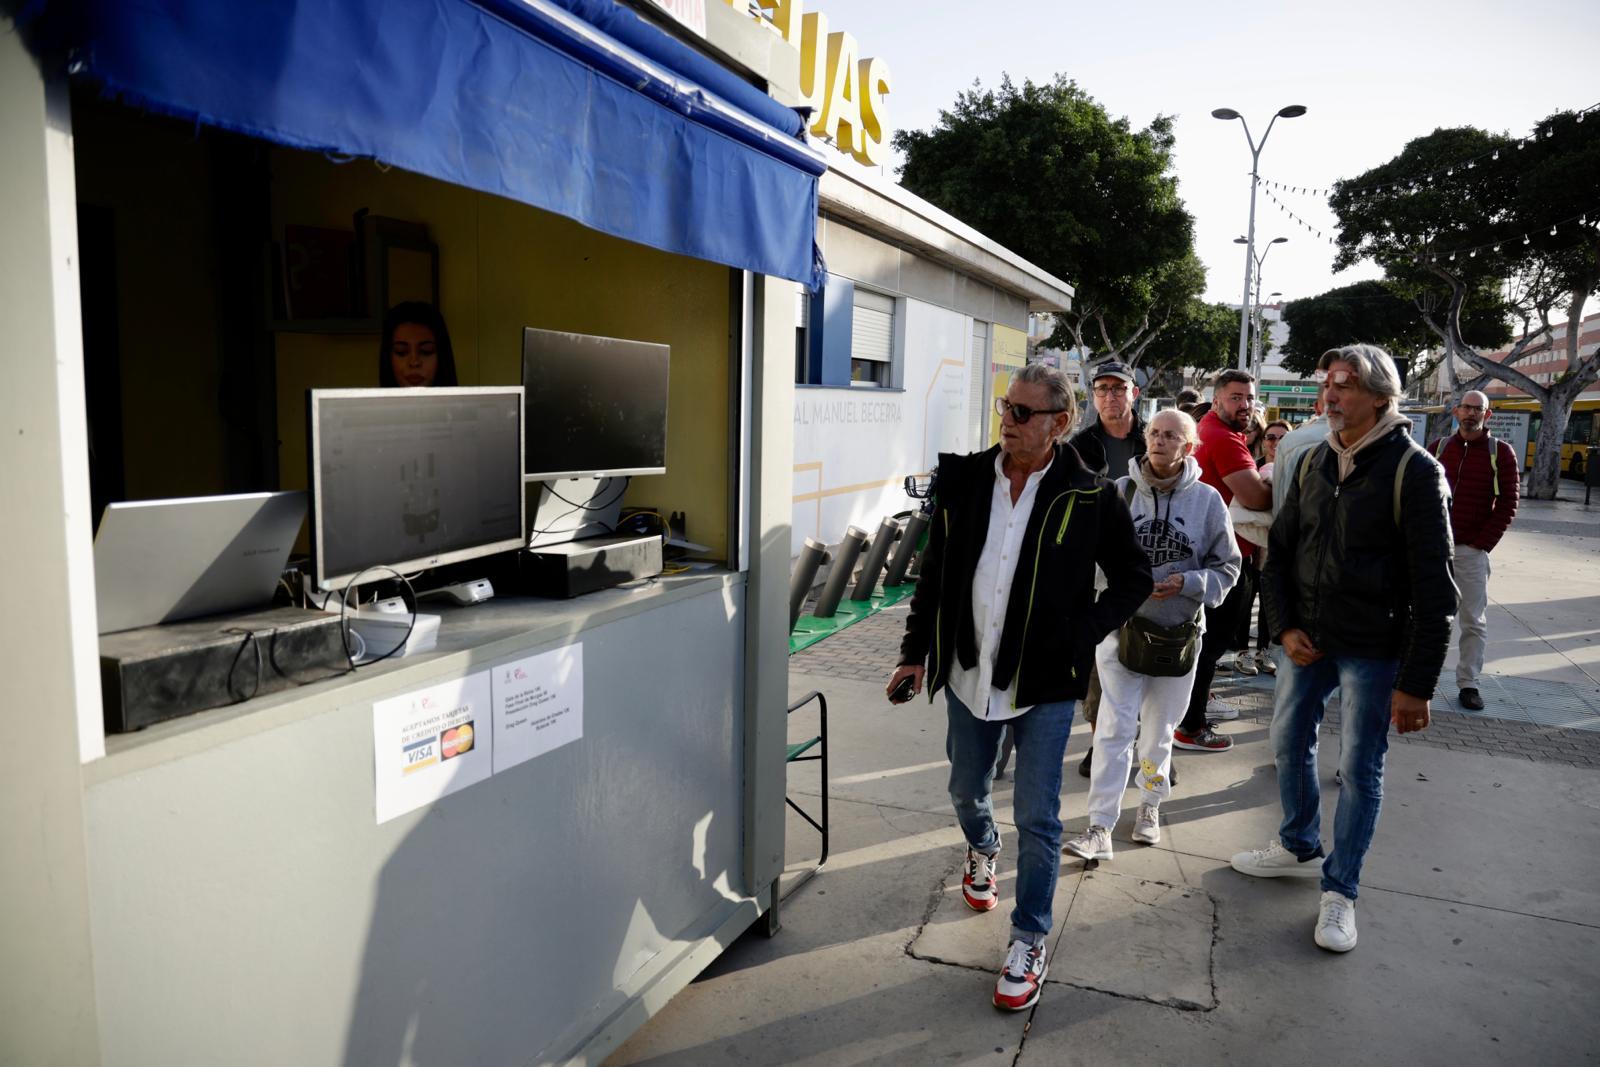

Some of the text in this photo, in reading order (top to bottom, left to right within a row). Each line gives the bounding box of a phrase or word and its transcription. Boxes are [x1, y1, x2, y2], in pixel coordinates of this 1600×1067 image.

[811, 401, 858, 424] MANUEL
[861, 402, 903, 424] BECERRA
[402, 705, 469, 733] ACEPTAMOS TARJETAS
[408, 745, 433, 763] VISA
